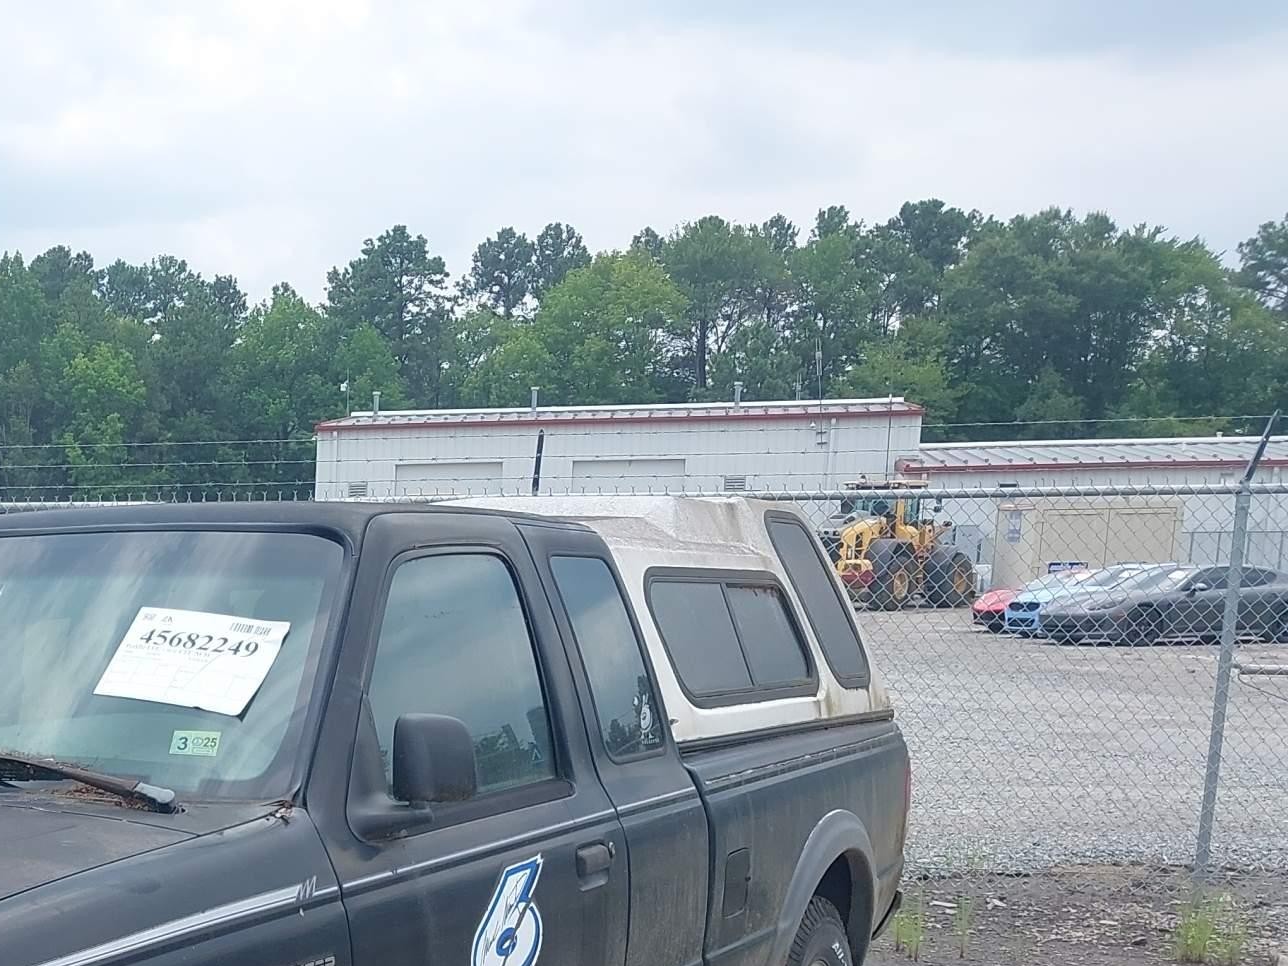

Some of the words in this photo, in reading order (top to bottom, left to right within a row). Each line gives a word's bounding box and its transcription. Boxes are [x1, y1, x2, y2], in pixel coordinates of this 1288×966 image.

[139, 628, 259, 658] 45682249
[176, 736, 188, 751] 3
[203, 736, 218, 749] 25
